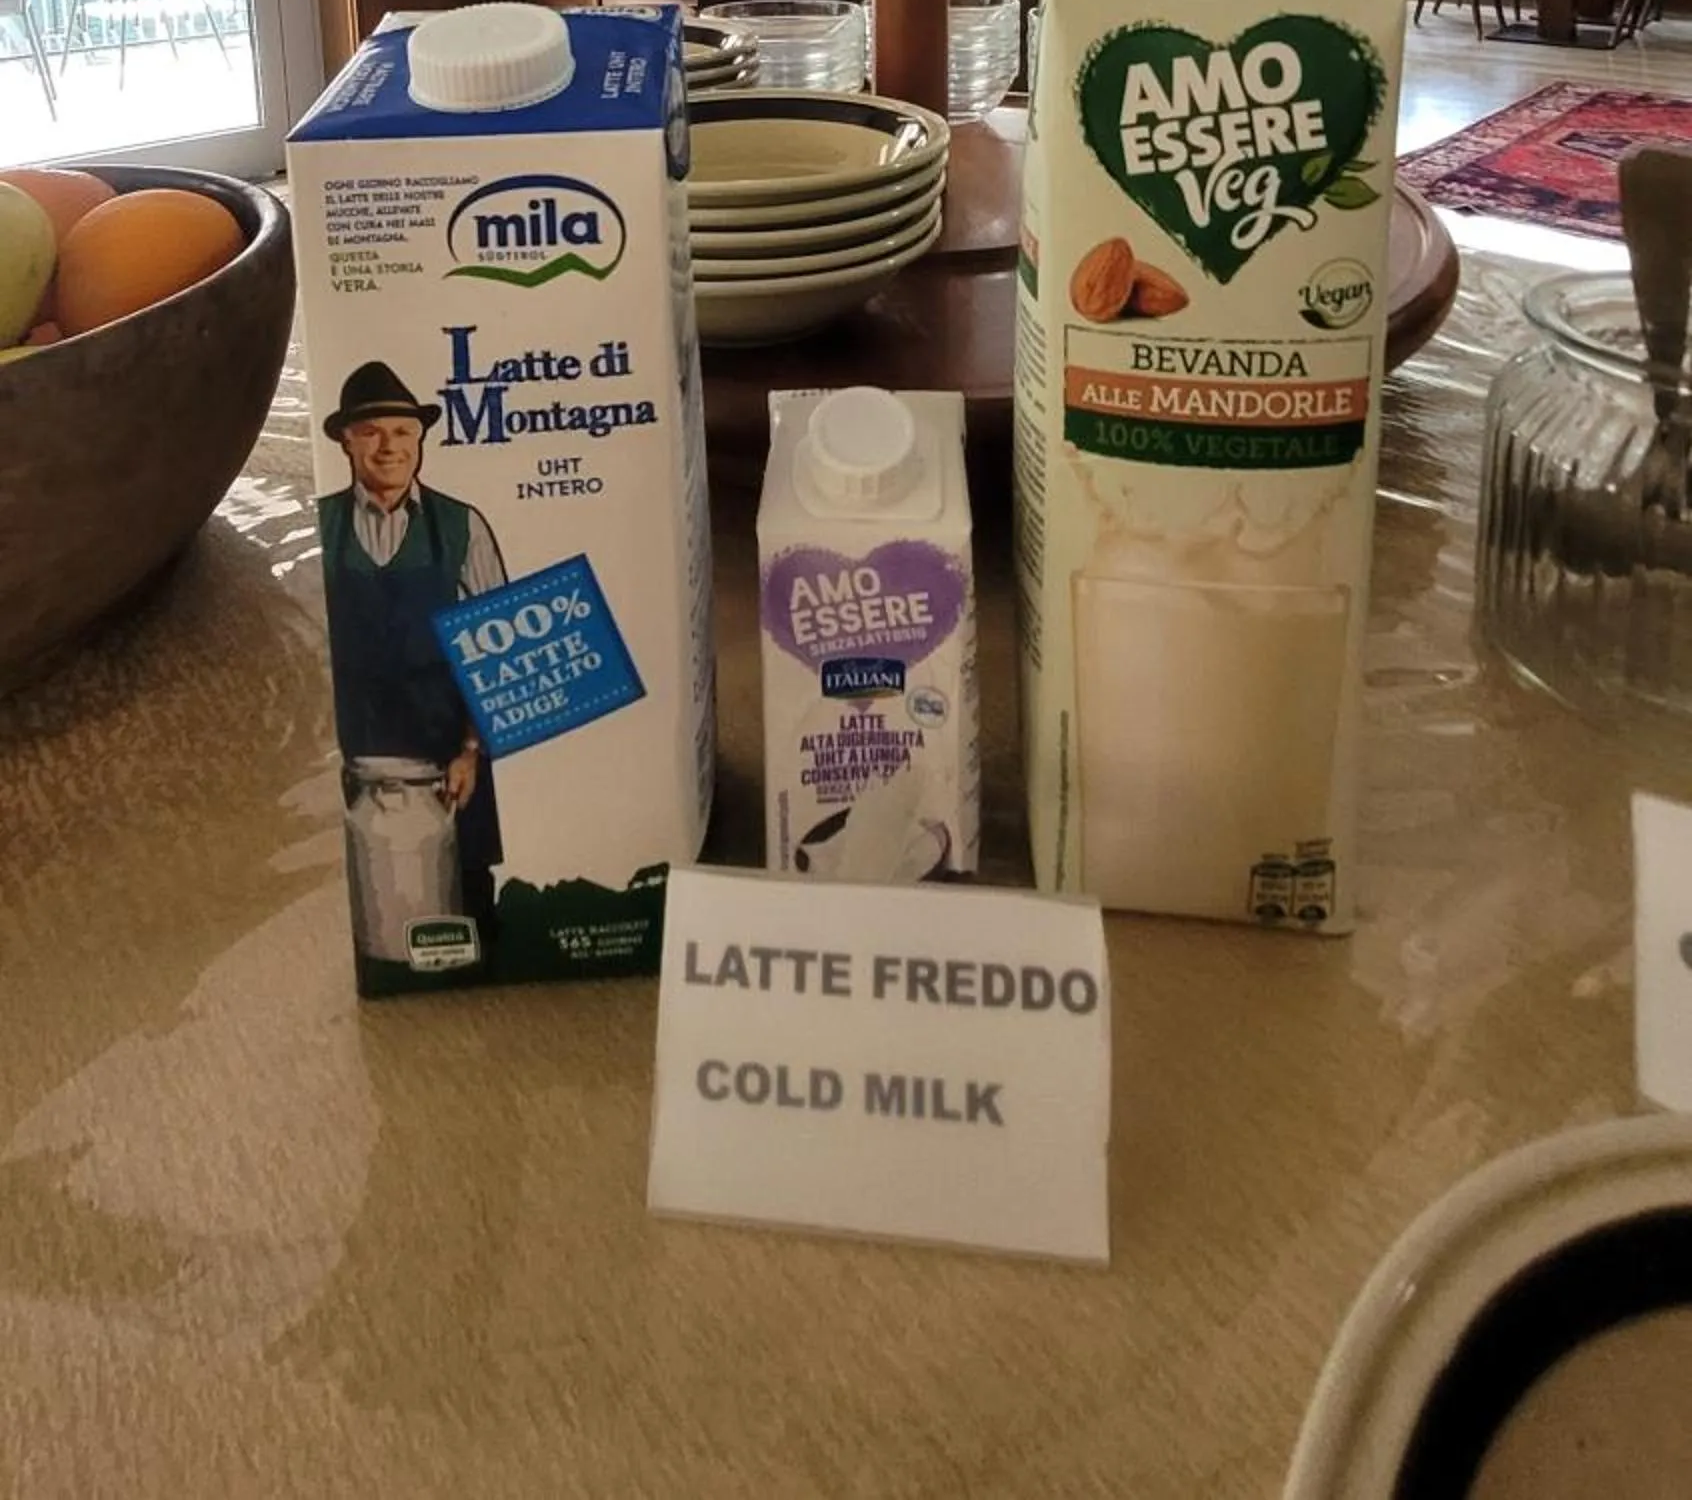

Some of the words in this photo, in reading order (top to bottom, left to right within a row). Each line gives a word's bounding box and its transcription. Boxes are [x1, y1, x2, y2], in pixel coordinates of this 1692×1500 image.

[1120, 41, 1302, 125] AMO
[1120, 100, 1328, 176] ESSERE
[324, 180, 355, 191] OGNI
[357, 178, 401, 189] GIORNO
[405, 175, 480, 187] RACCOGLIAMO
[338, 193, 369, 204] LATTE
[1174, 145, 1318, 250] Veg
[353, 219, 383, 230] CURA
[474, 198, 603, 248] mila
[377, 262, 424, 275] STORIA
[1299, 278, 1374, 312] Vegan
[441, 324, 582, 385] Latte
[589, 341, 633, 379] di
[1130, 343, 1308, 378] BEVANDA
[437, 384, 658, 447] Montagna
[1082, 383, 1142, 412] ALLE
[1149, 385, 1353, 420] MANDORLE
[1095, 421, 1174, 452] 100%
[1184, 431, 1339, 459] VEGETALE
[537, 458, 582, 476] UHT
[516, 477, 603, 499] INTERO
[789, 567, 880, 611] AMO
[450, 588, 592, 667] 100%
[791, 592, 933, 645] ESSERE
[467, 630, 590, 695] LATTE
[809, 638, 857, 657] SENZA
[480, 651, 603, 712] DELL'ALTO
[825, 672, 901, 689] ITALIANI
[490, 688, 571, 733] ADIGE
[840, 714, 886, 730] LATTE
[800, 734, 835, 751] ALTA
[814, 750, 845, 767] UHT
[849, 749, 859, 763] A
[860, 747, 911, 762] LUNGA
[684, 941, 852, 998] LATTE
[872, 954, 1099, 1015] FREDDO
[696, 1059, 844, 1110] COLD
[863, 1072, 1005, 1126] MILK
